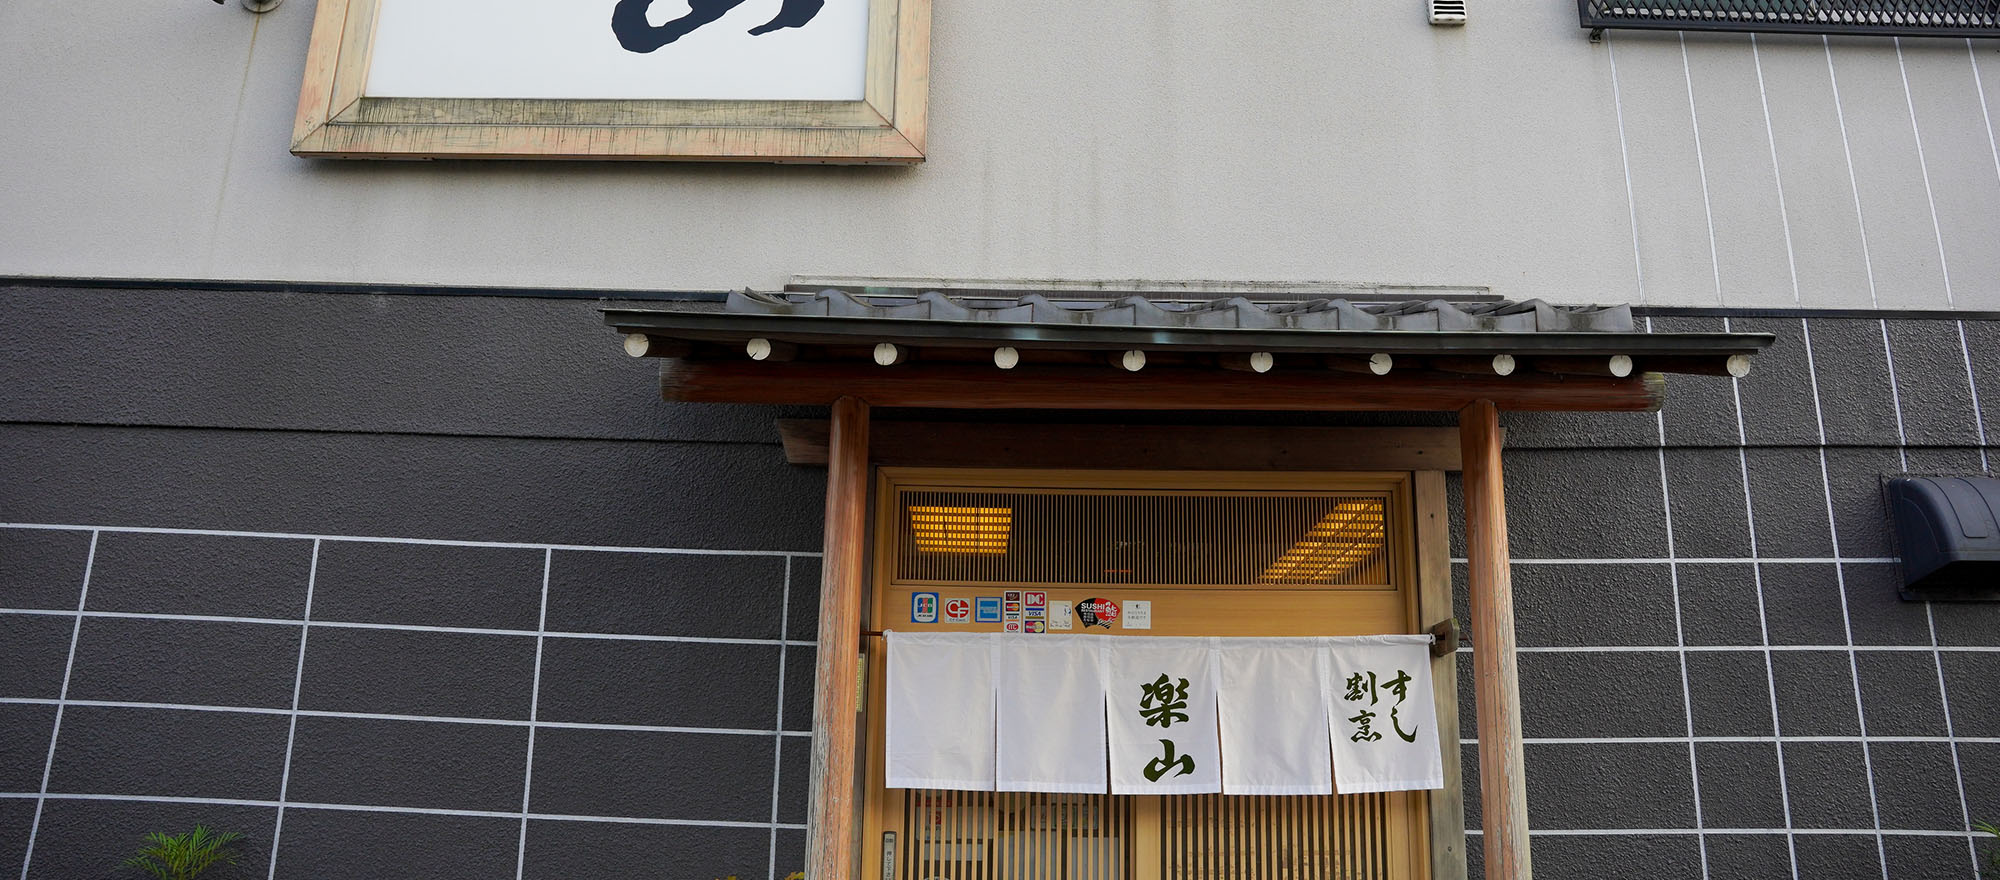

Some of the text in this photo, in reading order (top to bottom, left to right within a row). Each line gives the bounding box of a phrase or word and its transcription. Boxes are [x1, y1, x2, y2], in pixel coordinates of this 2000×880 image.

[1080, 602, 1105, 610] SUSHI
[1138, 672, 1196, 783] 楽山
[1343, 670, 1383, 743] 割烹
[1380, 669, 1418, 744] すし
